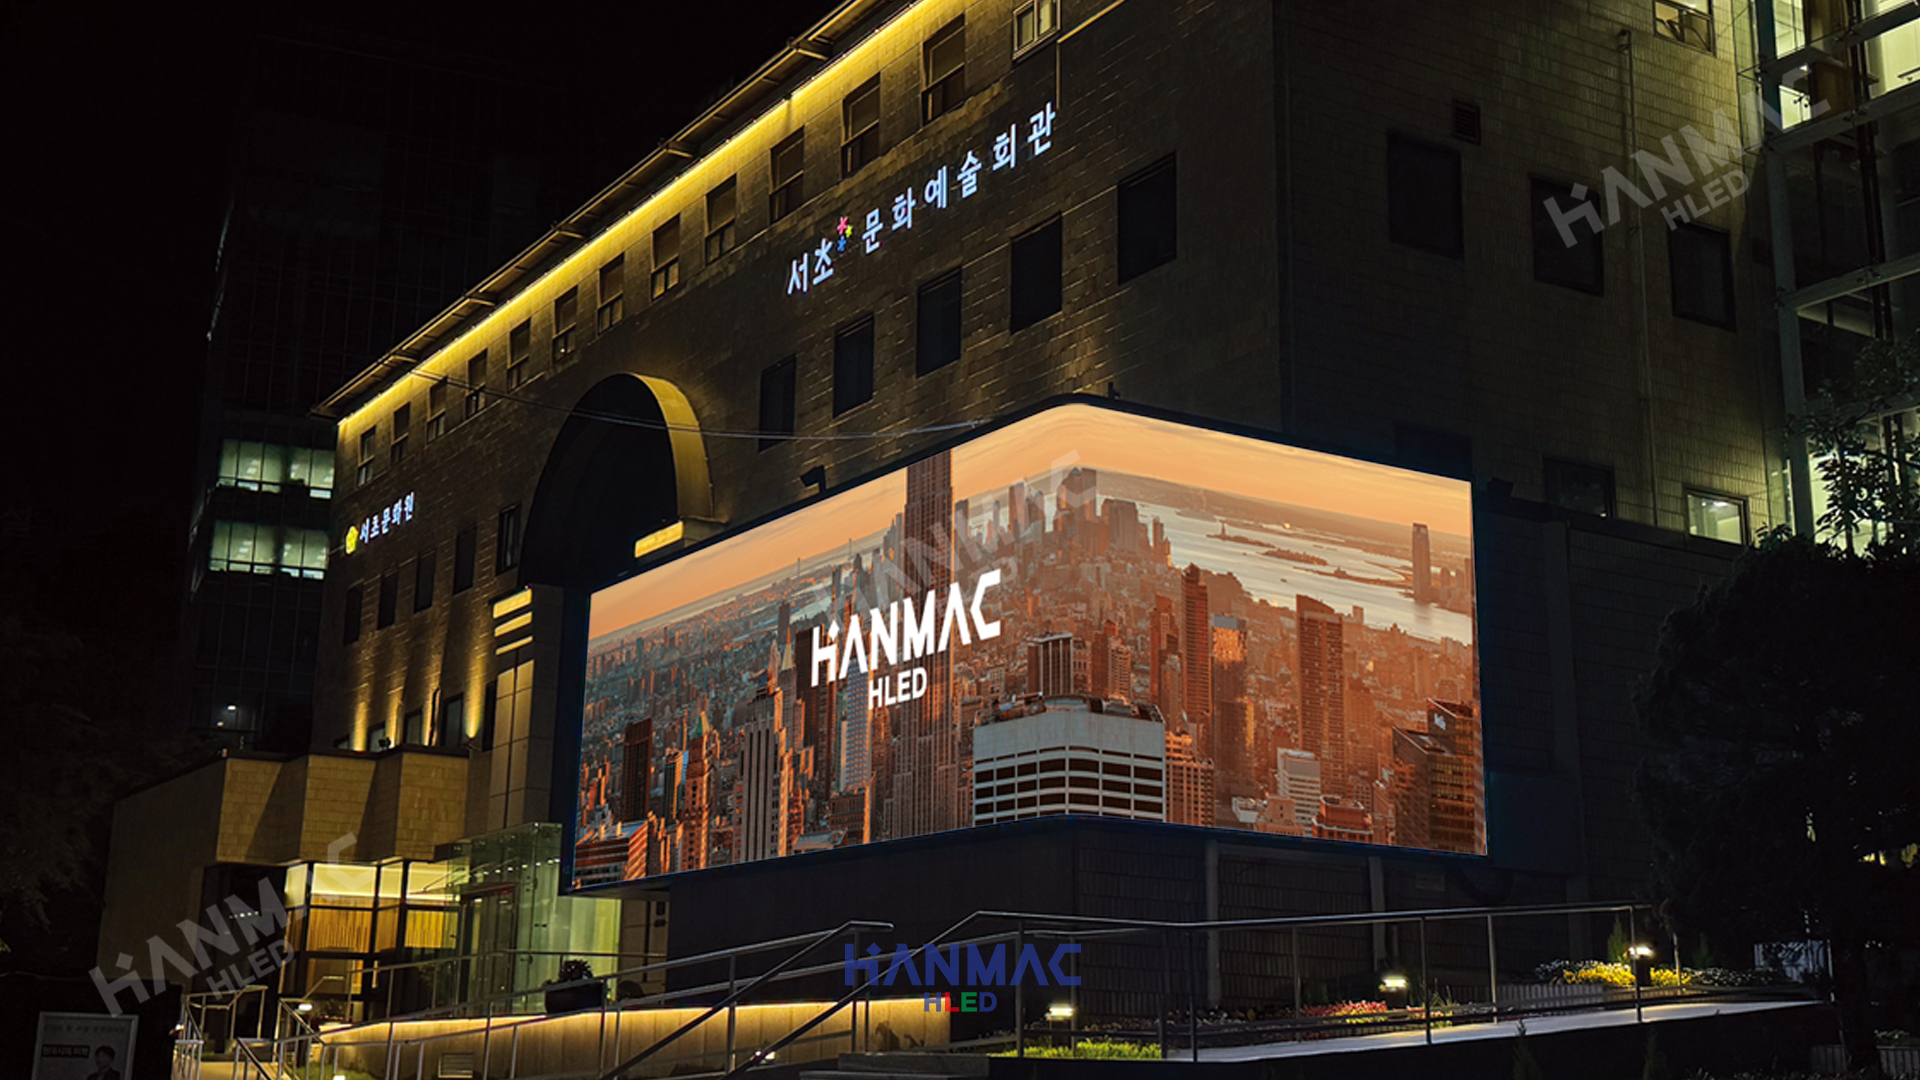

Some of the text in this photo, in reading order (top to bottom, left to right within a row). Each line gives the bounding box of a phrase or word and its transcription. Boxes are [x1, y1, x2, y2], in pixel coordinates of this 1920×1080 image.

[787, 102, 1056, 295] 서초 문화예술회관
[359, 491, 415, 544] 서초문화원
[810, 568, 1001, 687] HANMAC
[868, 667, 928, 709] HLED
